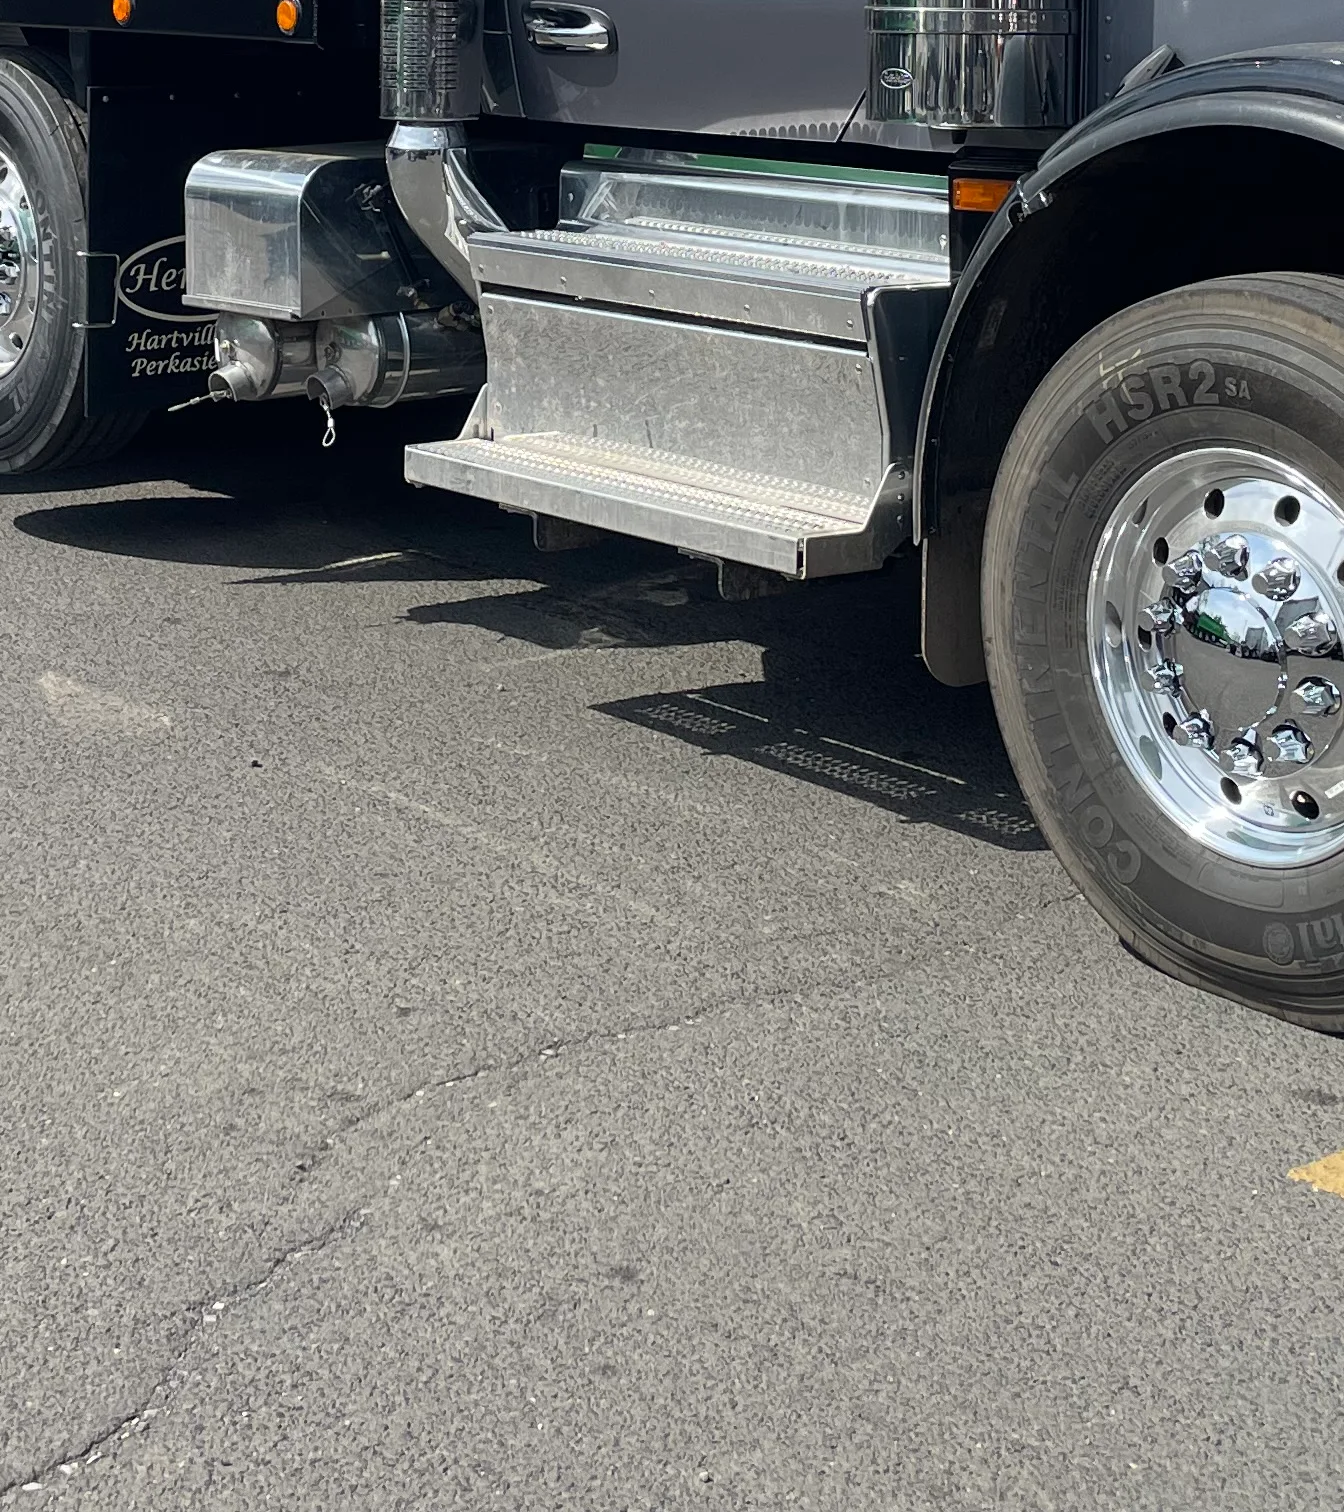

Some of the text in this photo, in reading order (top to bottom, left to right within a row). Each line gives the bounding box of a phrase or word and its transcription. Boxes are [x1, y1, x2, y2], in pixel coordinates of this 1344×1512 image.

[1084, 360, 1253, 445] HSR2 SA
[1013, 463, 1142, 885] CONTINENTAL
